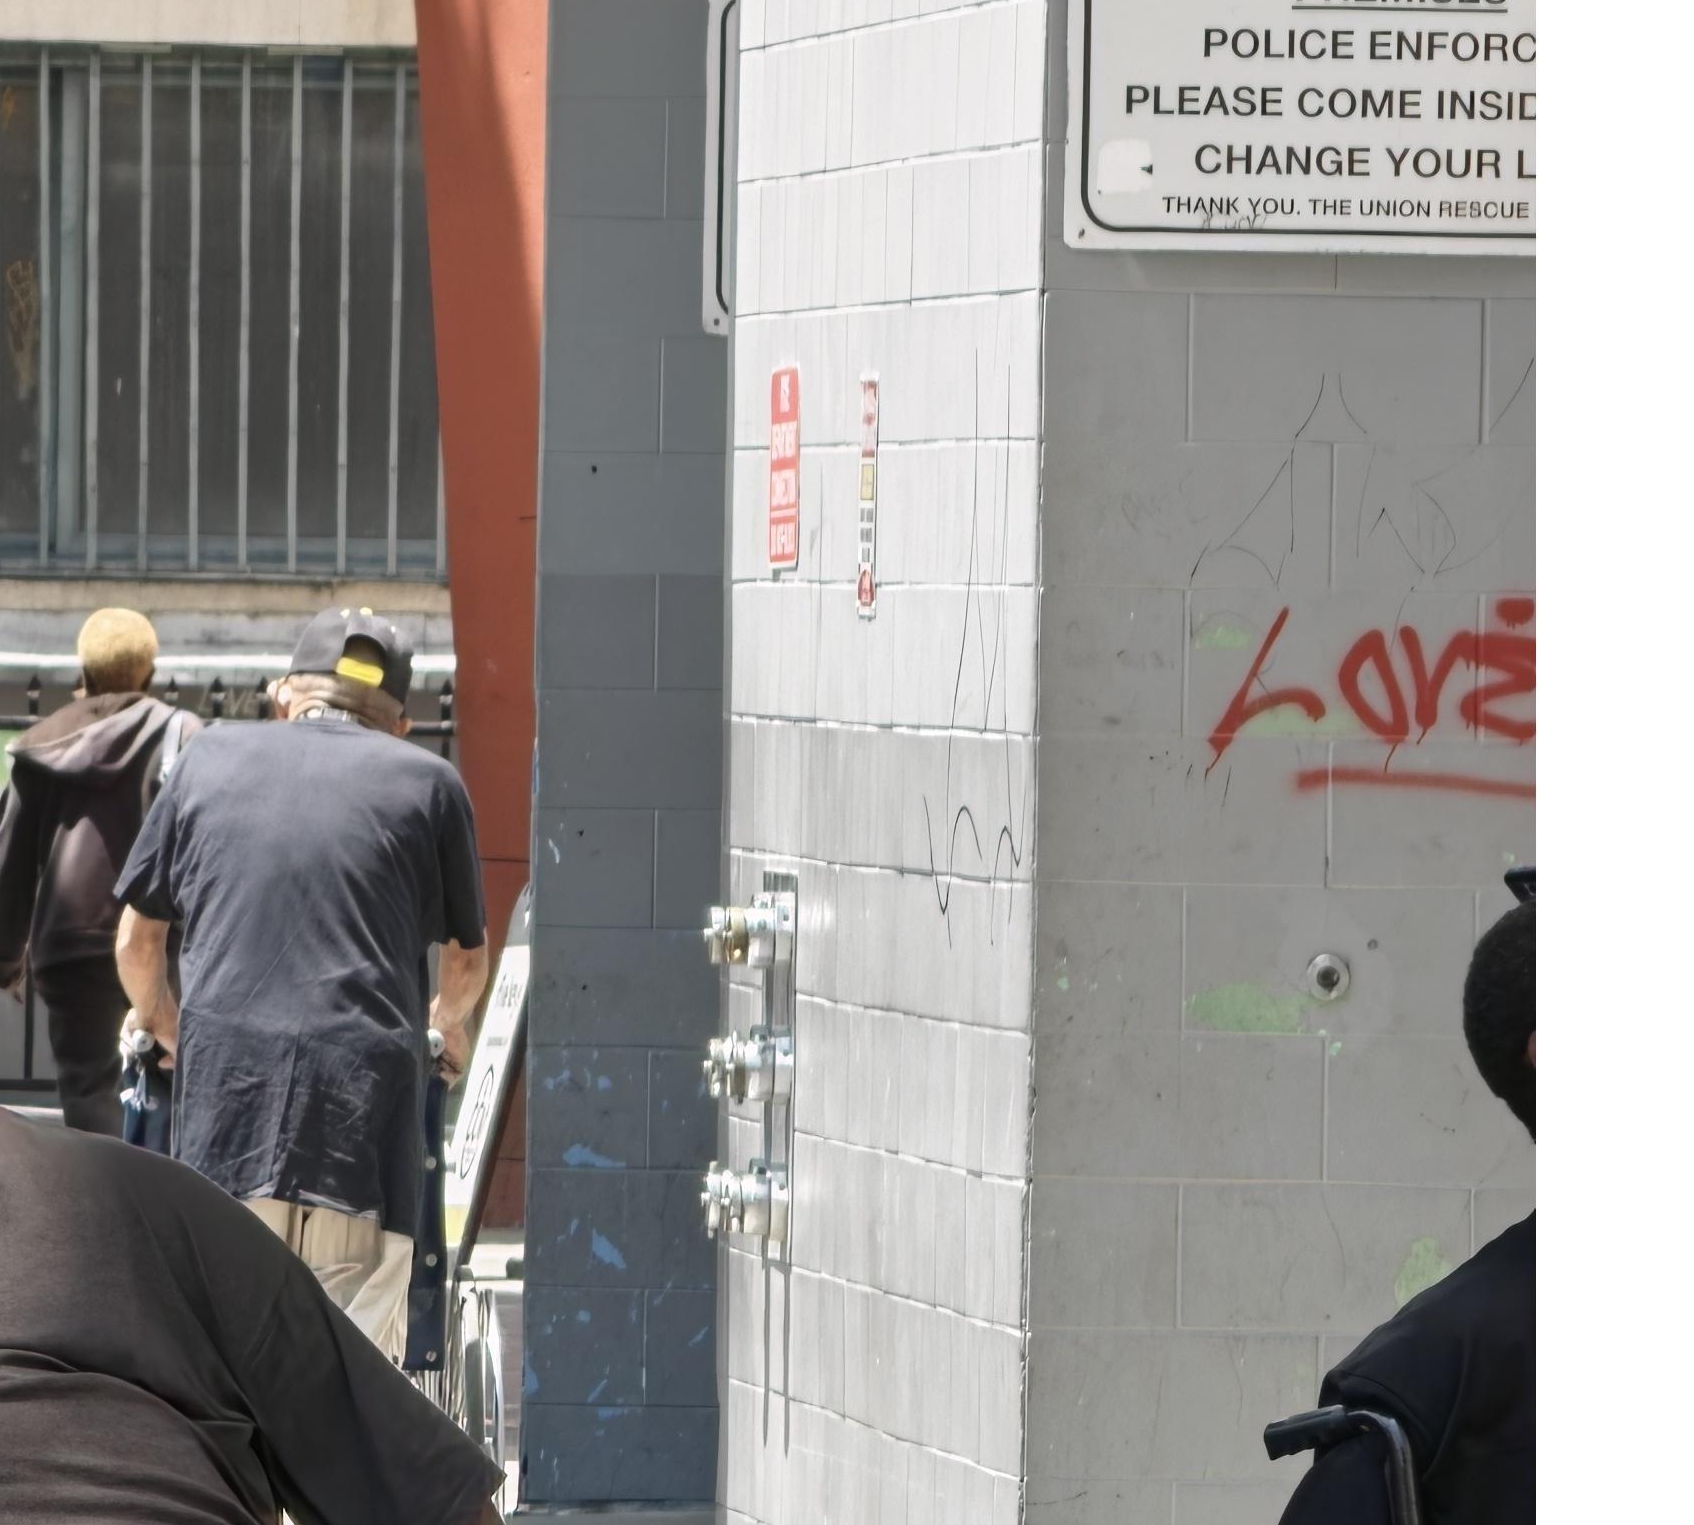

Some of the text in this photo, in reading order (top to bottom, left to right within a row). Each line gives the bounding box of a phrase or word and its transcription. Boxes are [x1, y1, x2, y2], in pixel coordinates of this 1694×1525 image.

[1203, 28, 1535, 63] POLICE ENFORC
[1125, 85, 1283, 117] PLEASE
[1297, 87, 1422, 119] COME
[1194, 144, 1371, 177] CHANGE
[1385, 147, 1501, 179] YOUR
[1162, 196, 1239, 216] THANK
[1247, 197, 1301, 217] YOU.
[1308, 198, 1352, 216] THE
[1359, 199, 1432, 218] UNION
